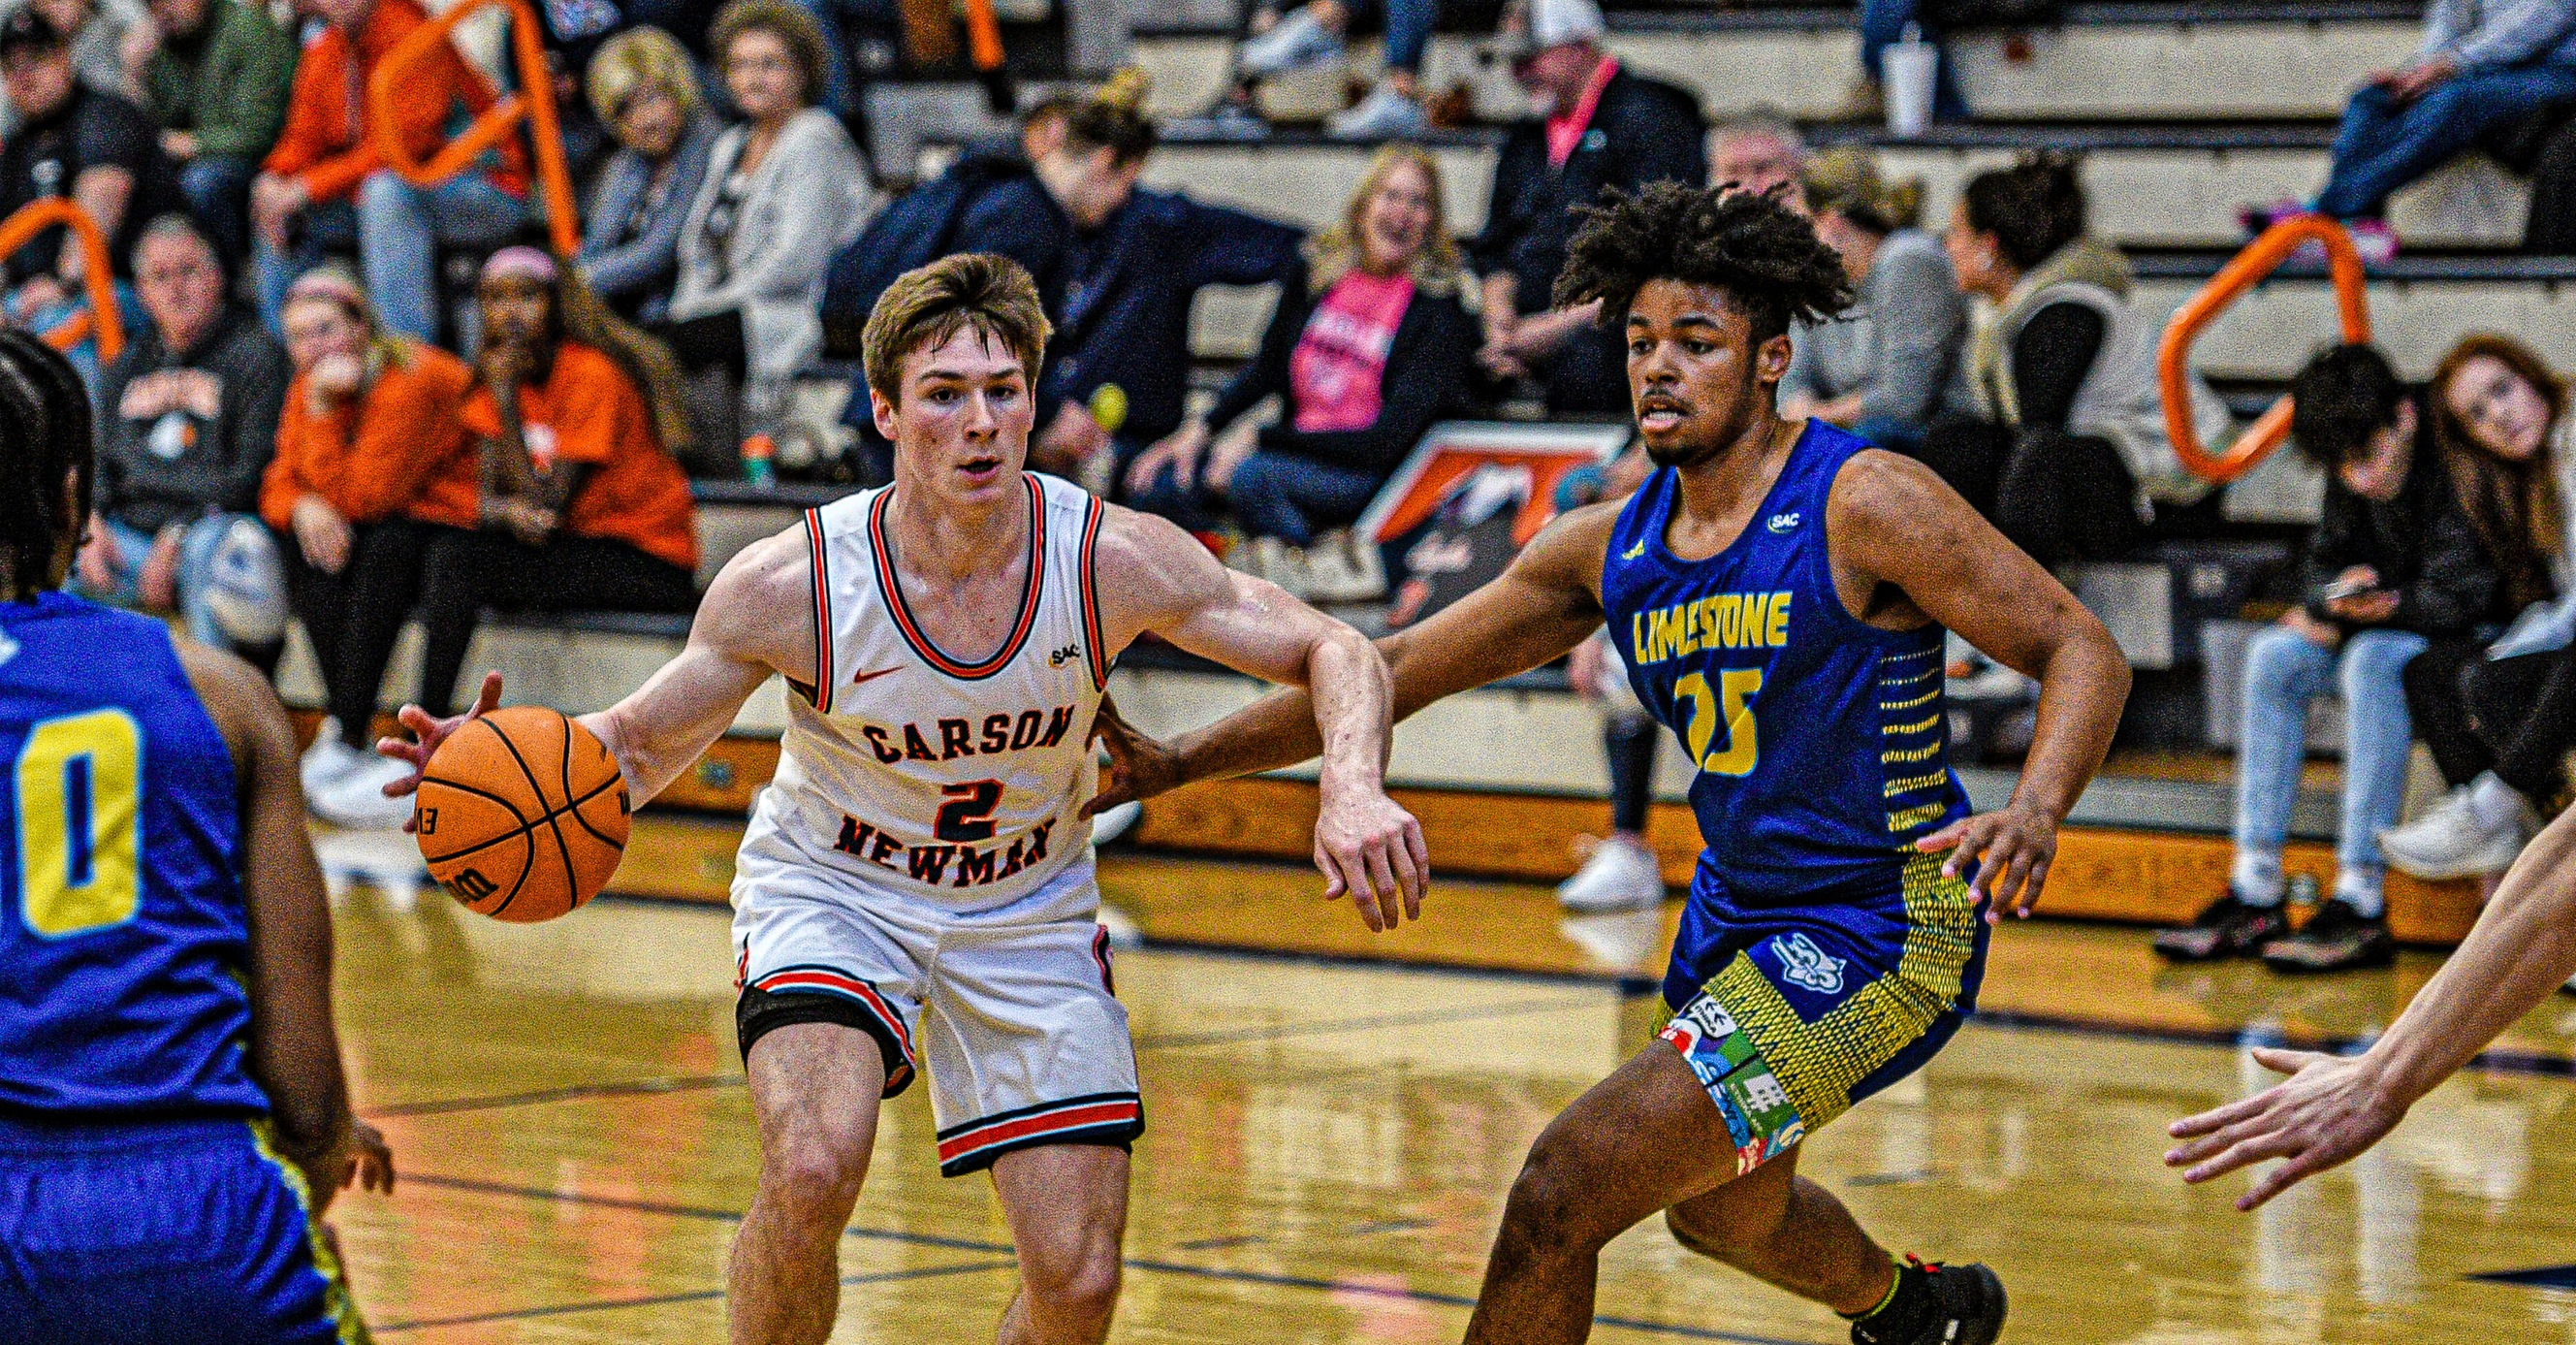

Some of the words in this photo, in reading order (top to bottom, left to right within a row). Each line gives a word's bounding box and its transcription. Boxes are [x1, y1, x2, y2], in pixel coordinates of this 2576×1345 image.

[1772, 513, 1800, 528] SAC
[1052, 644, 1080, 664] SAC
[1633, 590, 1794, 665] LIMESTONE
[862, 704, 1075, 763] CARSON
[1673, 667, 1760, 777] 25
[14, 707, 143, 940] 0
[933, 778, 1004, 842] 2
[834, 815, 1057, 887] NEWMAN
